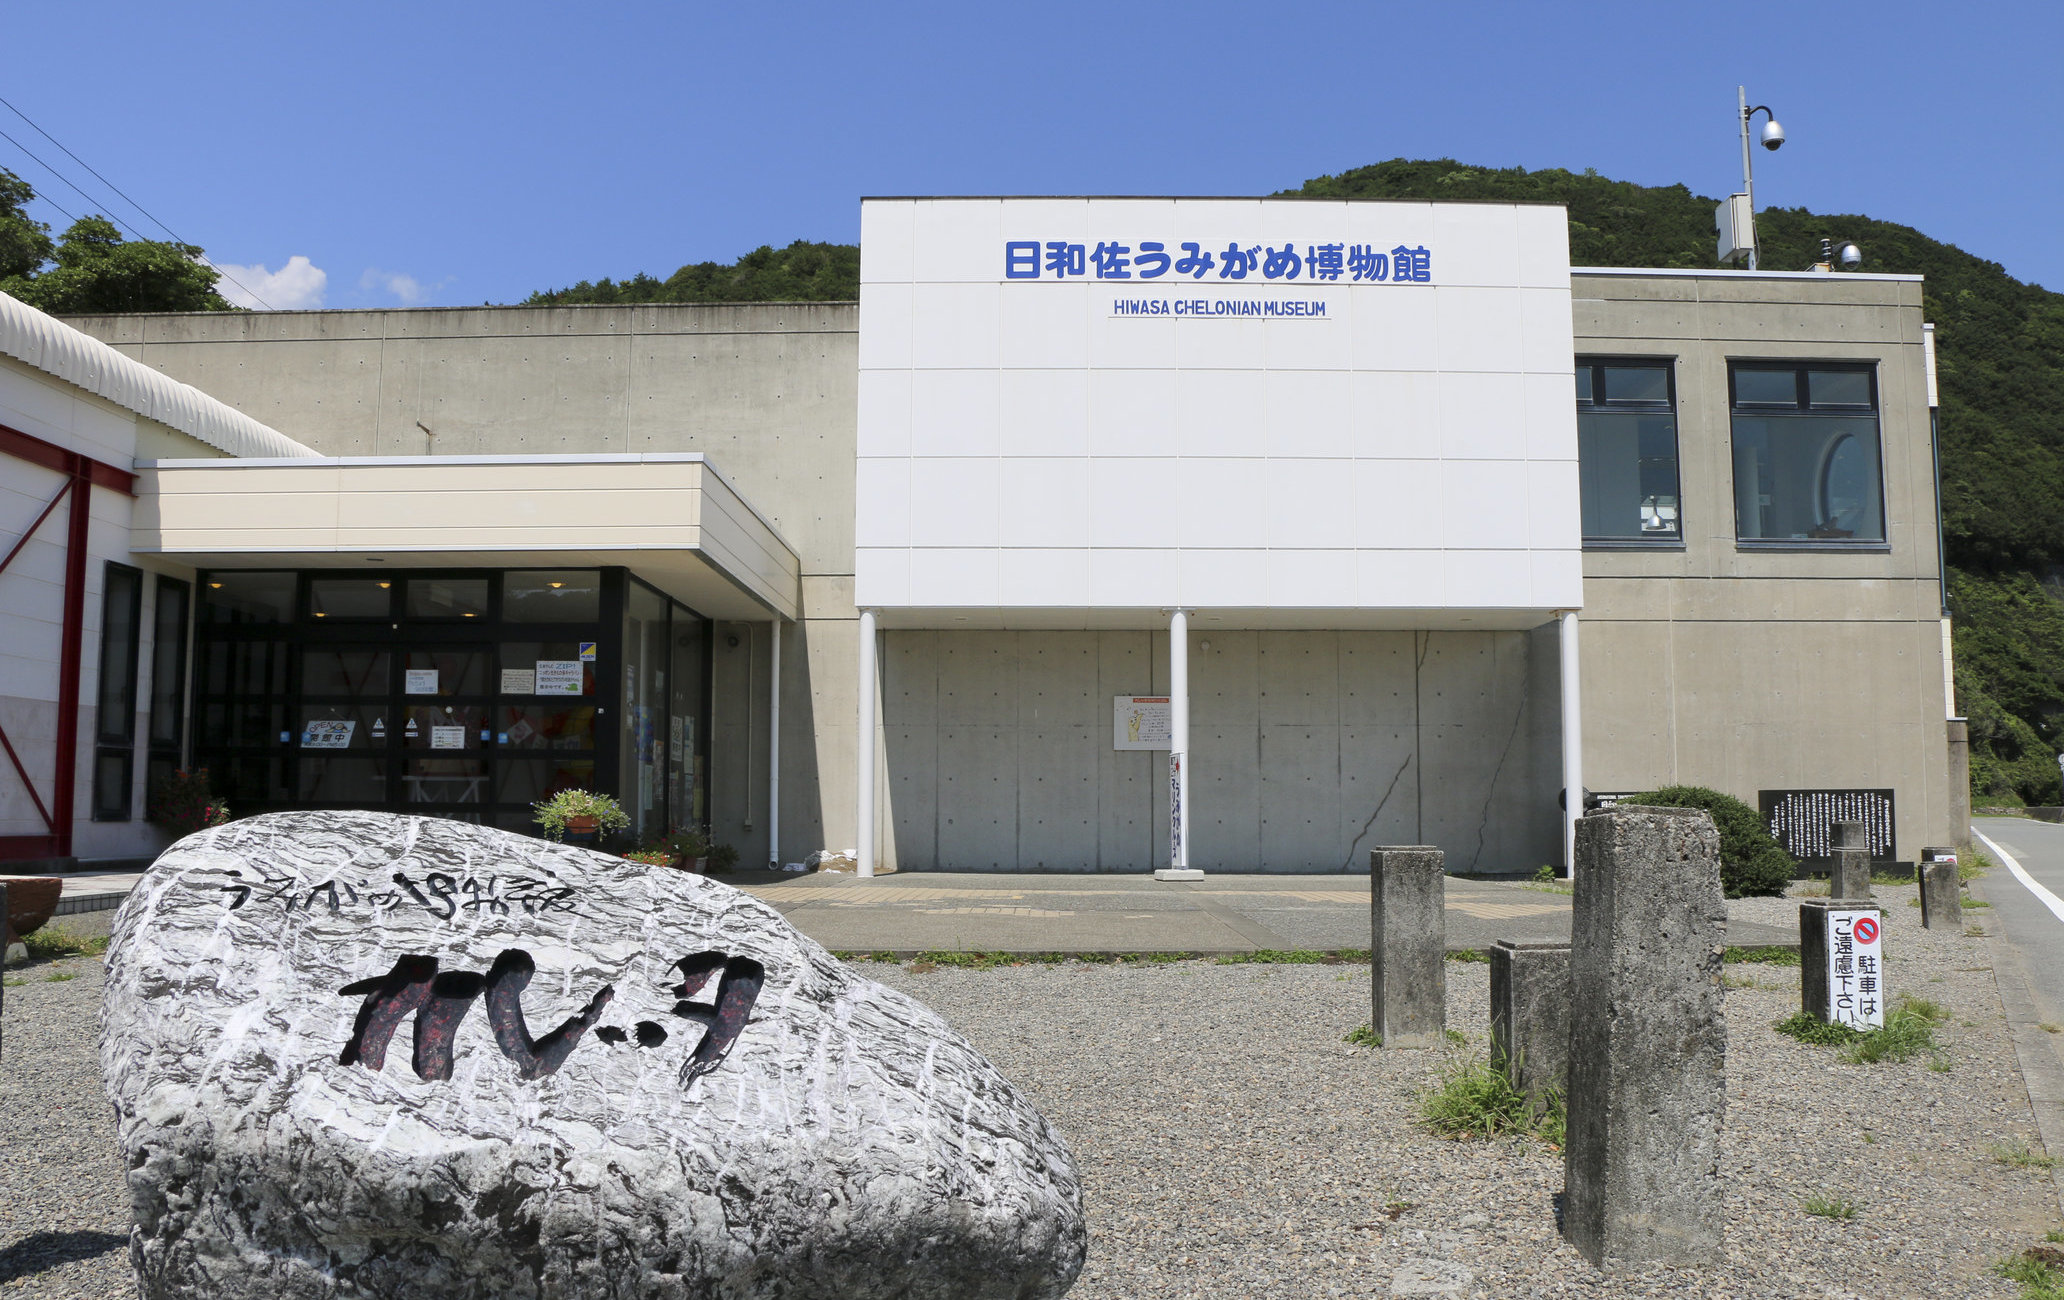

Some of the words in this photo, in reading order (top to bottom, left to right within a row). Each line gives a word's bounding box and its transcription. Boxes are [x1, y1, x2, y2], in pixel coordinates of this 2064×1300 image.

[1005, 240, 1431, 283] 日和佐うみがめ博物館
[1114, 299, 1171, 315] HIWASA
[1174, 299, 1262, 316] CHELONIAN
[1264, 300, 1326, 316] MUSEUM
[309, 721, 334, 733] OPEN
[1857, 955, 1878, 1016] 駐車は
